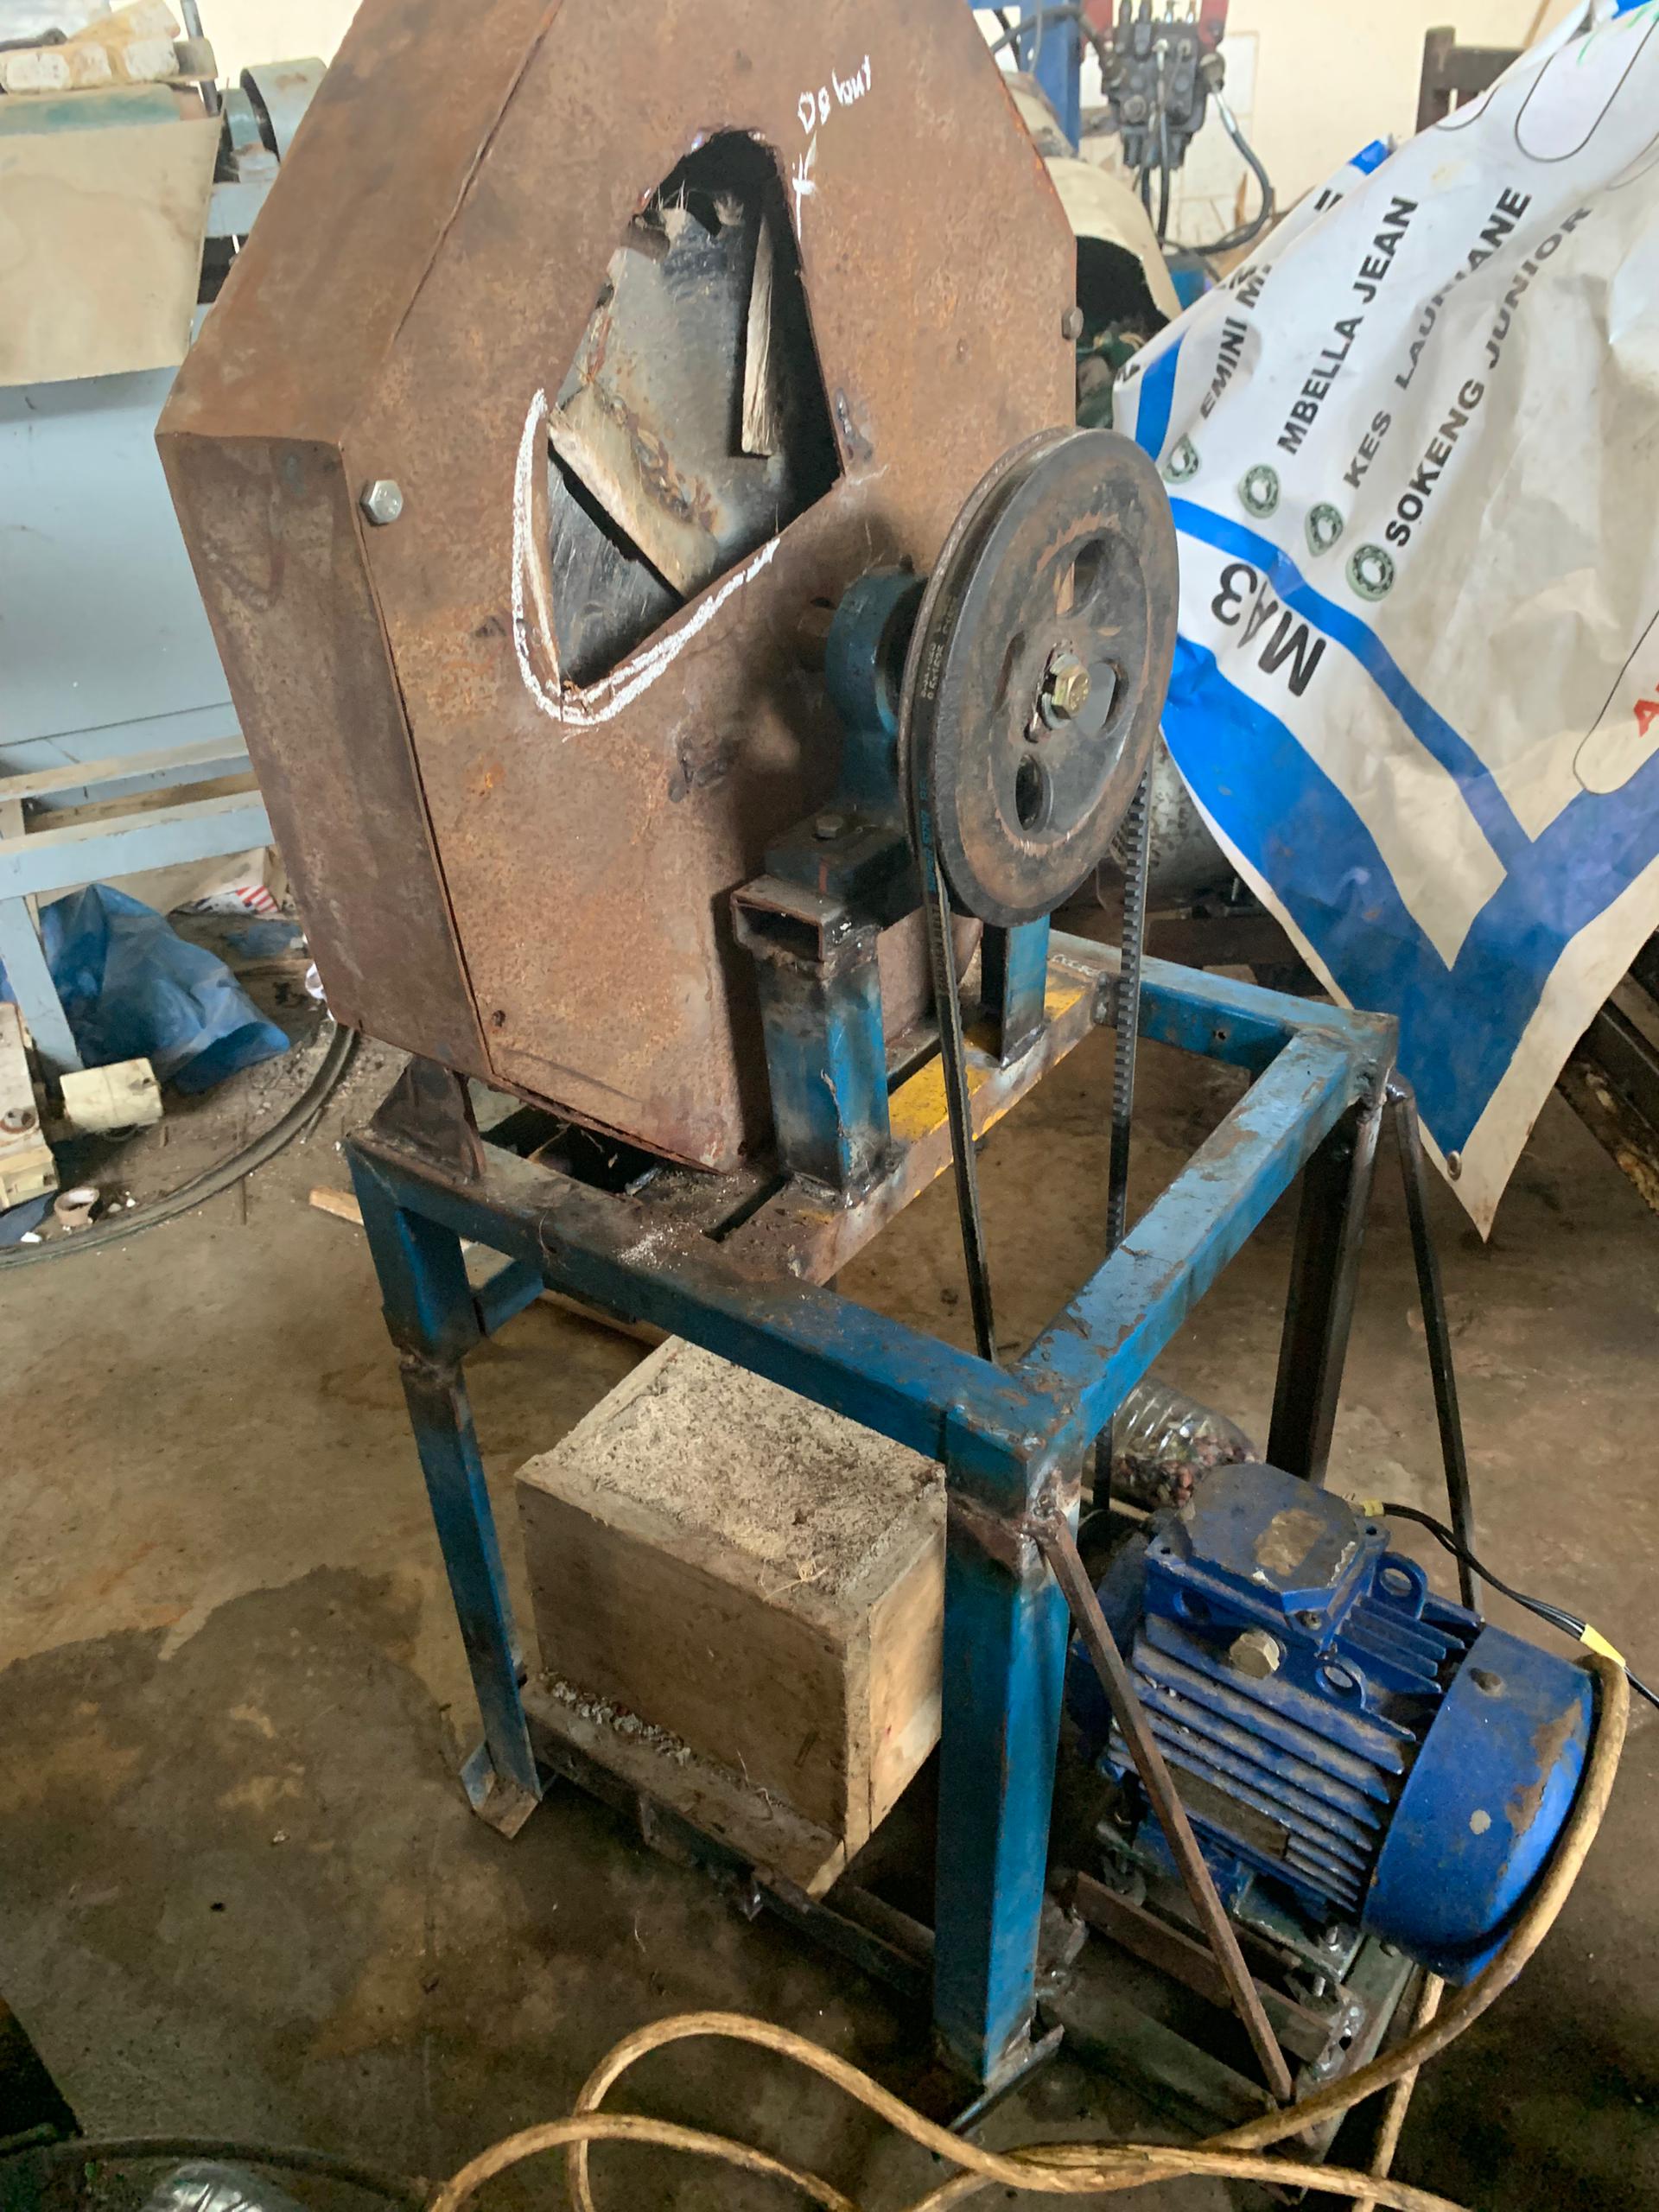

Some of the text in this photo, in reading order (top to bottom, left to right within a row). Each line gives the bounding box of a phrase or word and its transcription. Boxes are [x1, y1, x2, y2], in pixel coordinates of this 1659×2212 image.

[1277, 195, 1419, 455] MBELLA JEAN
[1385, 207, 1593, 547] SOKENG JUNIOR
